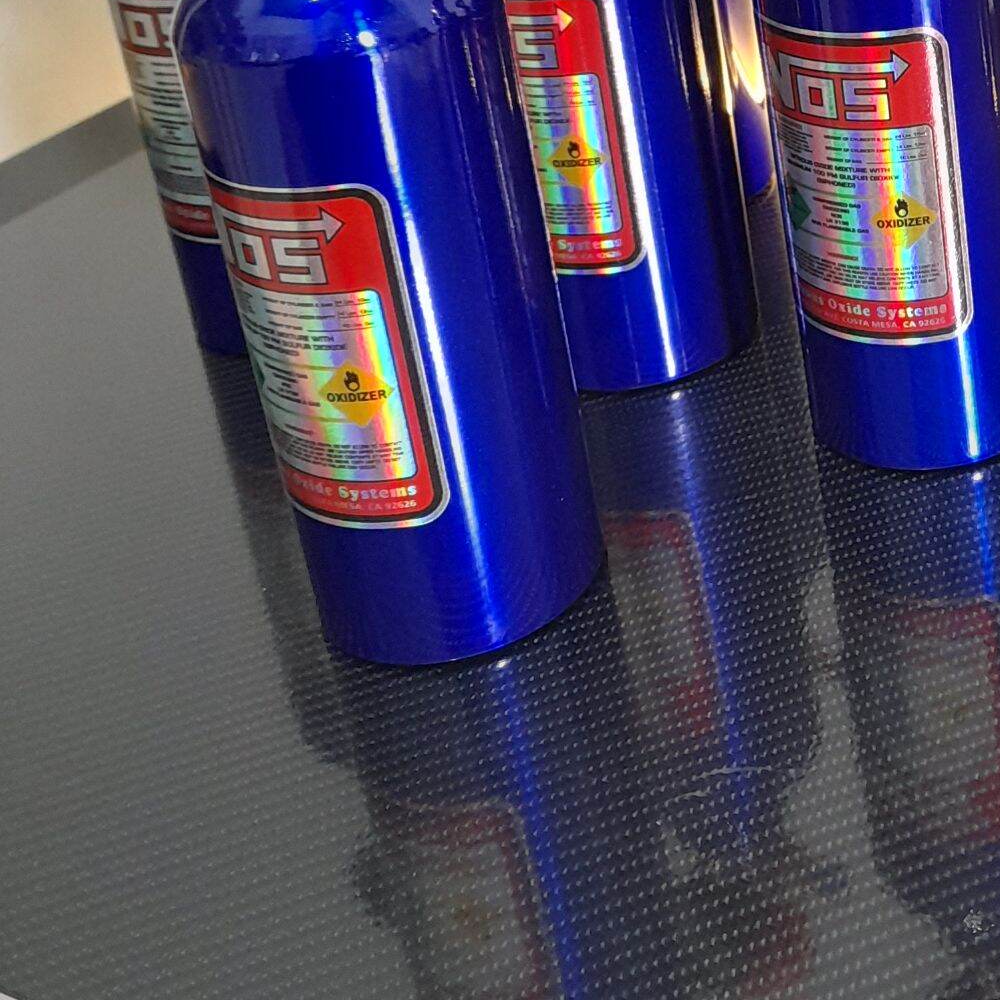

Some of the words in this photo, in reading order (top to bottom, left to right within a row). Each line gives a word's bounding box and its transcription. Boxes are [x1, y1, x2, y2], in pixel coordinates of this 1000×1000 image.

[876, 216, 930, 228] OXIDIZER
[828, 299, 871, 317] Oxide
[876, 304, 946, 321] Systems
[903, 320, 916, 328] CA
[326, 389, 387, 403] OXIDIZER
[338, 485, 417, 501] Systems
